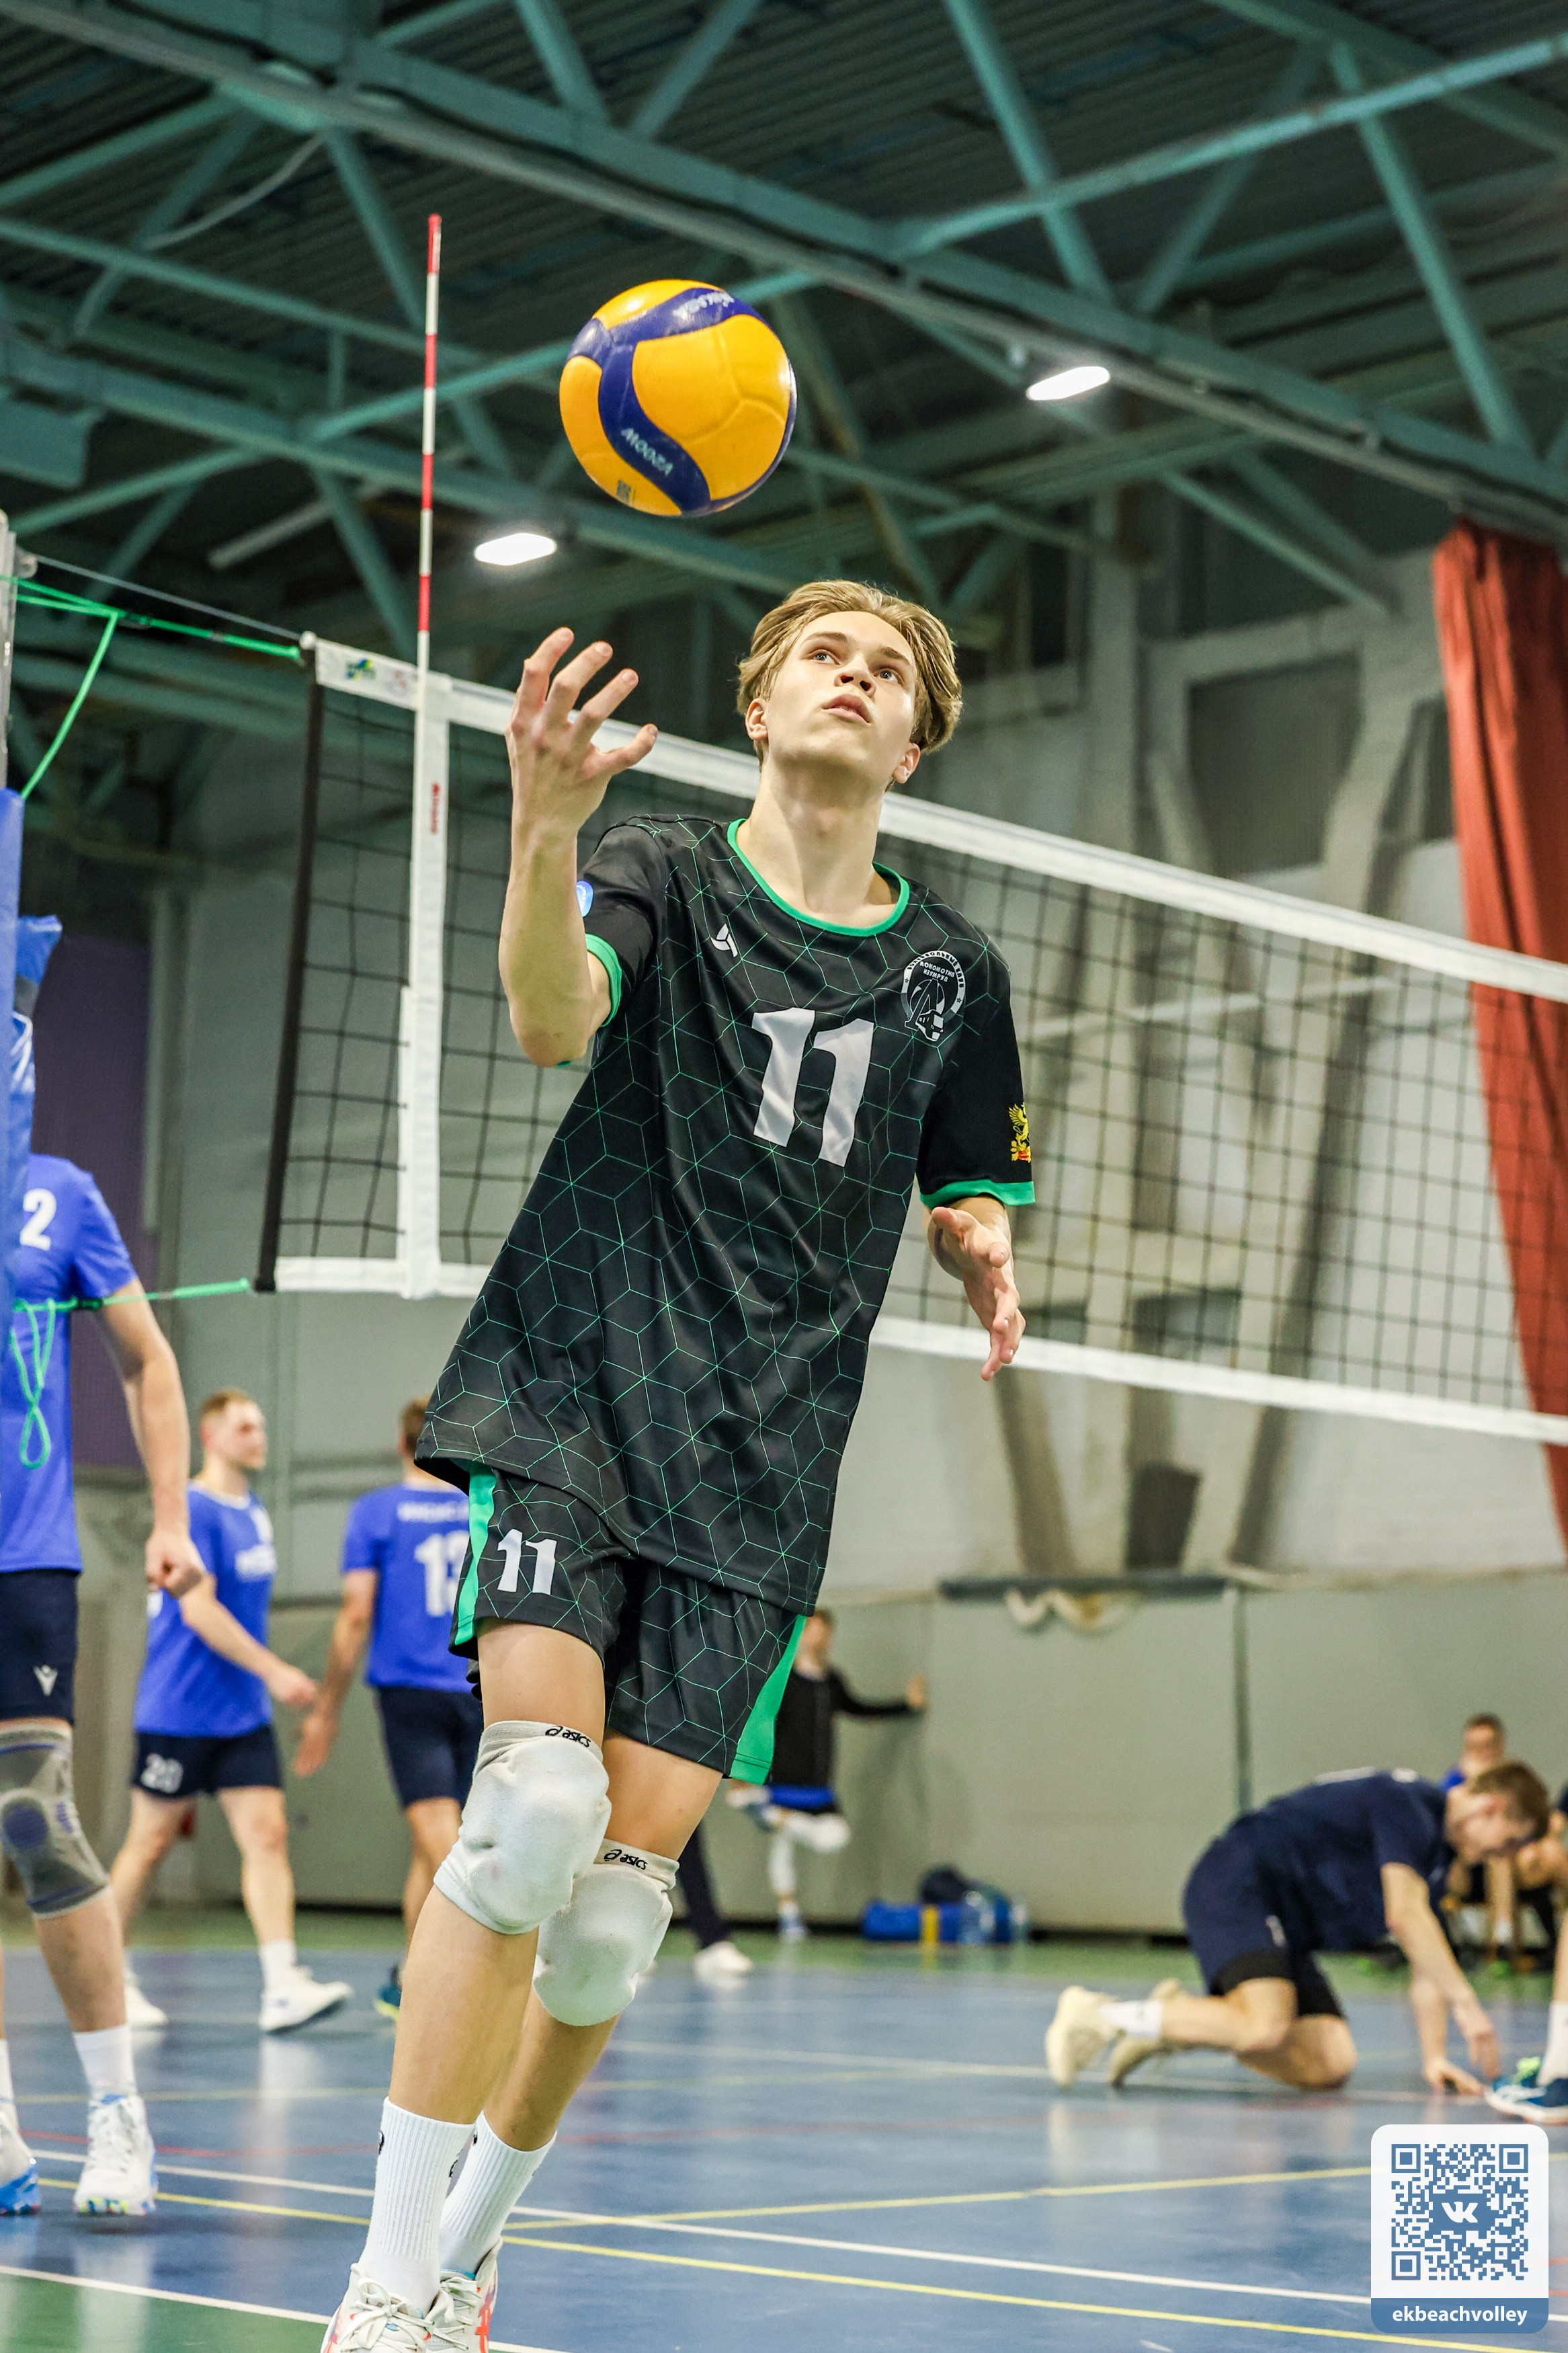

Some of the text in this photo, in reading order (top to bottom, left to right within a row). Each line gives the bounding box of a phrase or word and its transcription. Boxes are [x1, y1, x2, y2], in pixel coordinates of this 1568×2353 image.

[919, 961, 955, 978] ЛОКОМОТИВ
[923, 969, 948, 982] ИЗУМРУД
[751, 1007, 874, 1167] 11
[497, 1528, 557, 1595] 11
[562, 1728, 591, 1748] asics
[620, 1853, 648, 1870] asics
